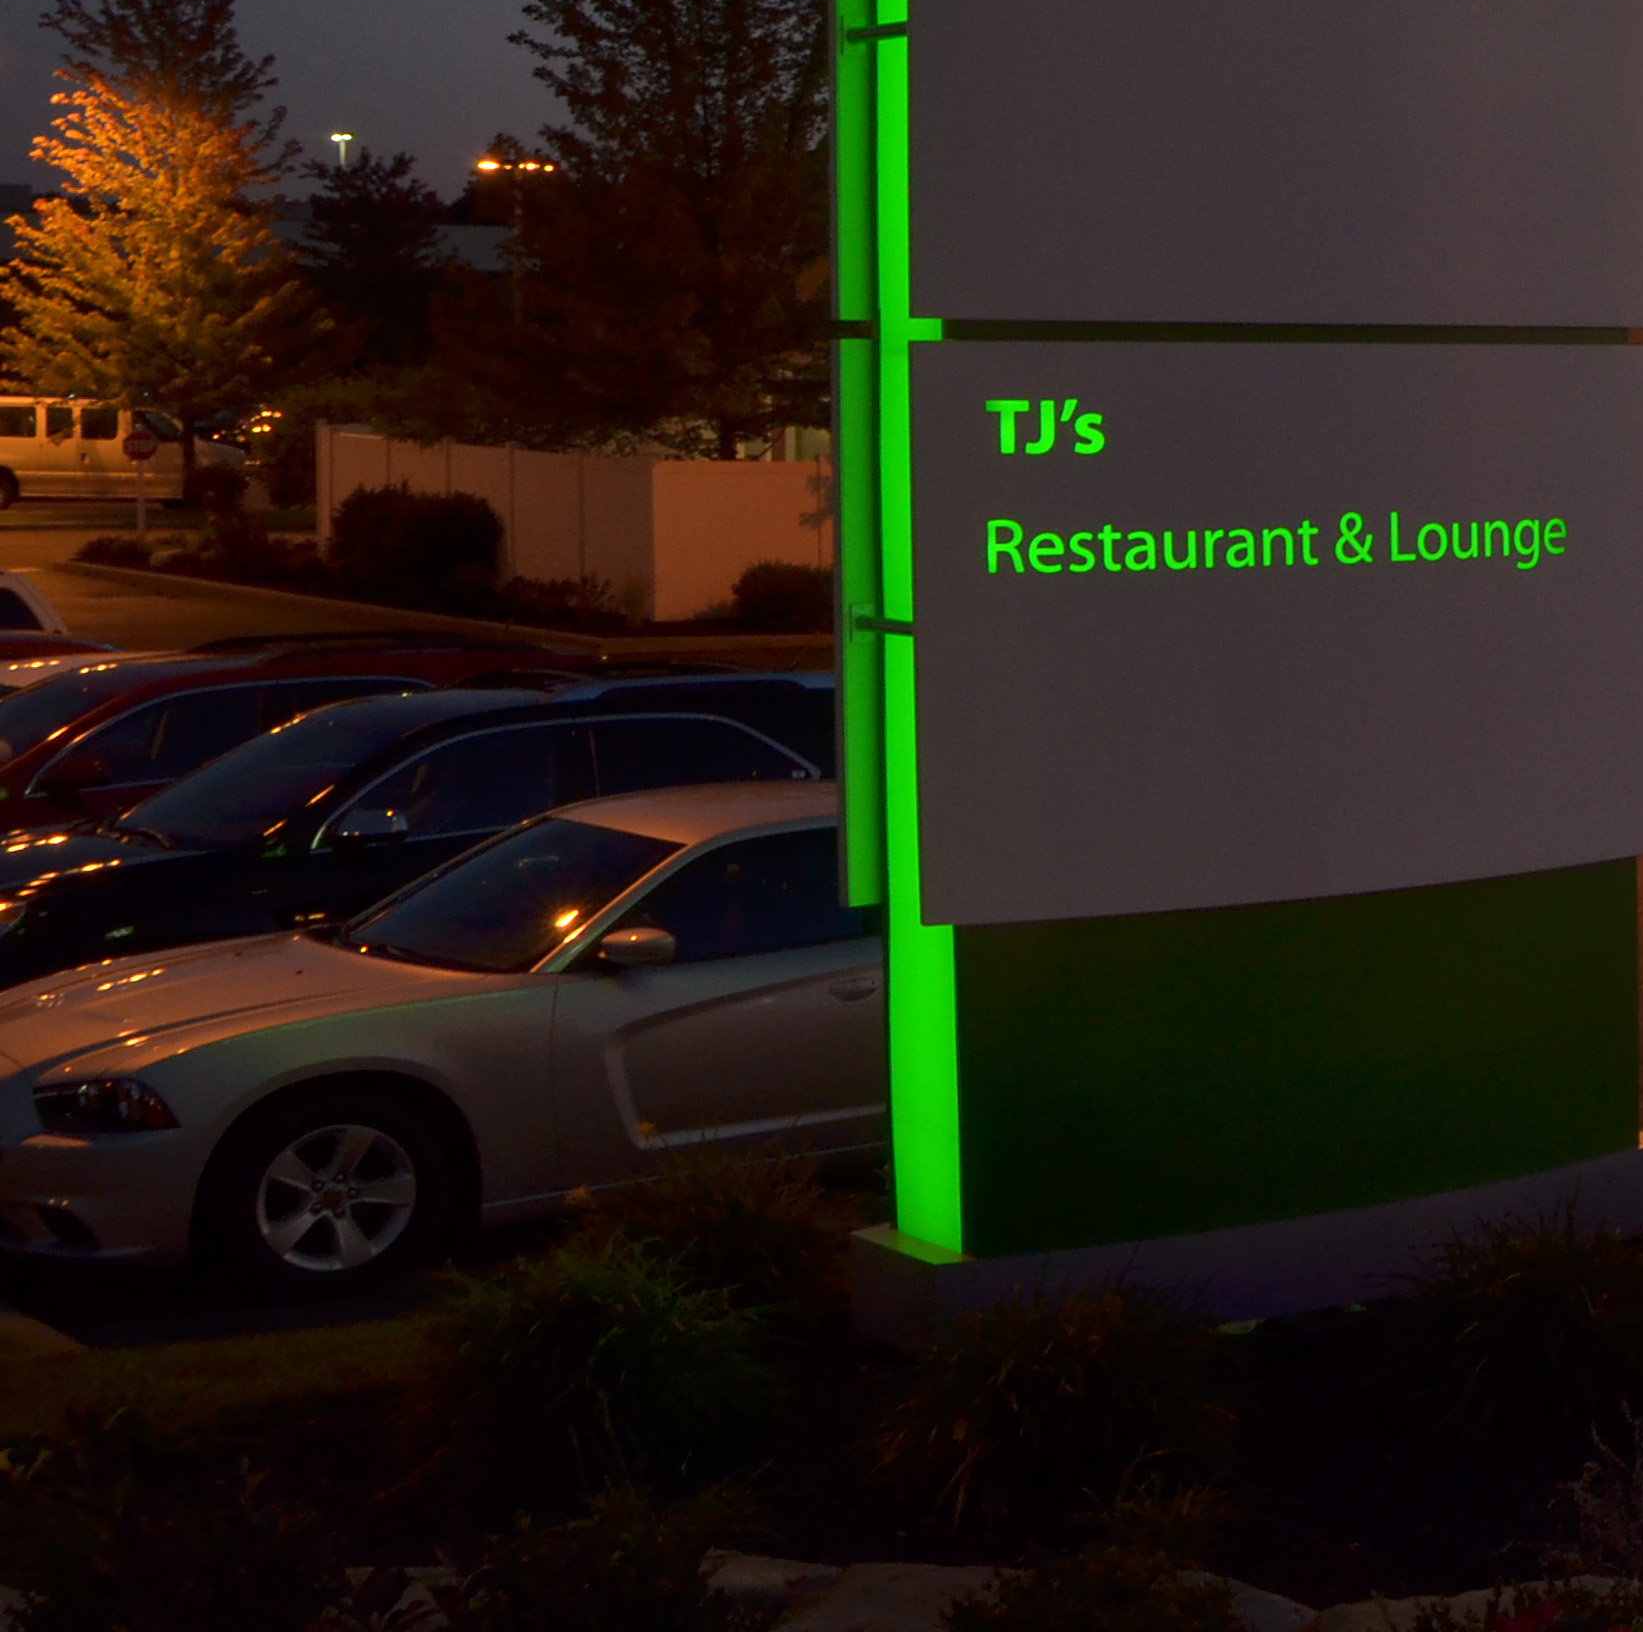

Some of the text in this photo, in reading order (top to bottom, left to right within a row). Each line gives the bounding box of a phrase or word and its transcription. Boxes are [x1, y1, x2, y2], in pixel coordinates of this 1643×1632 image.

[986, 511, 1567, 574] Restaurant & Lounge
